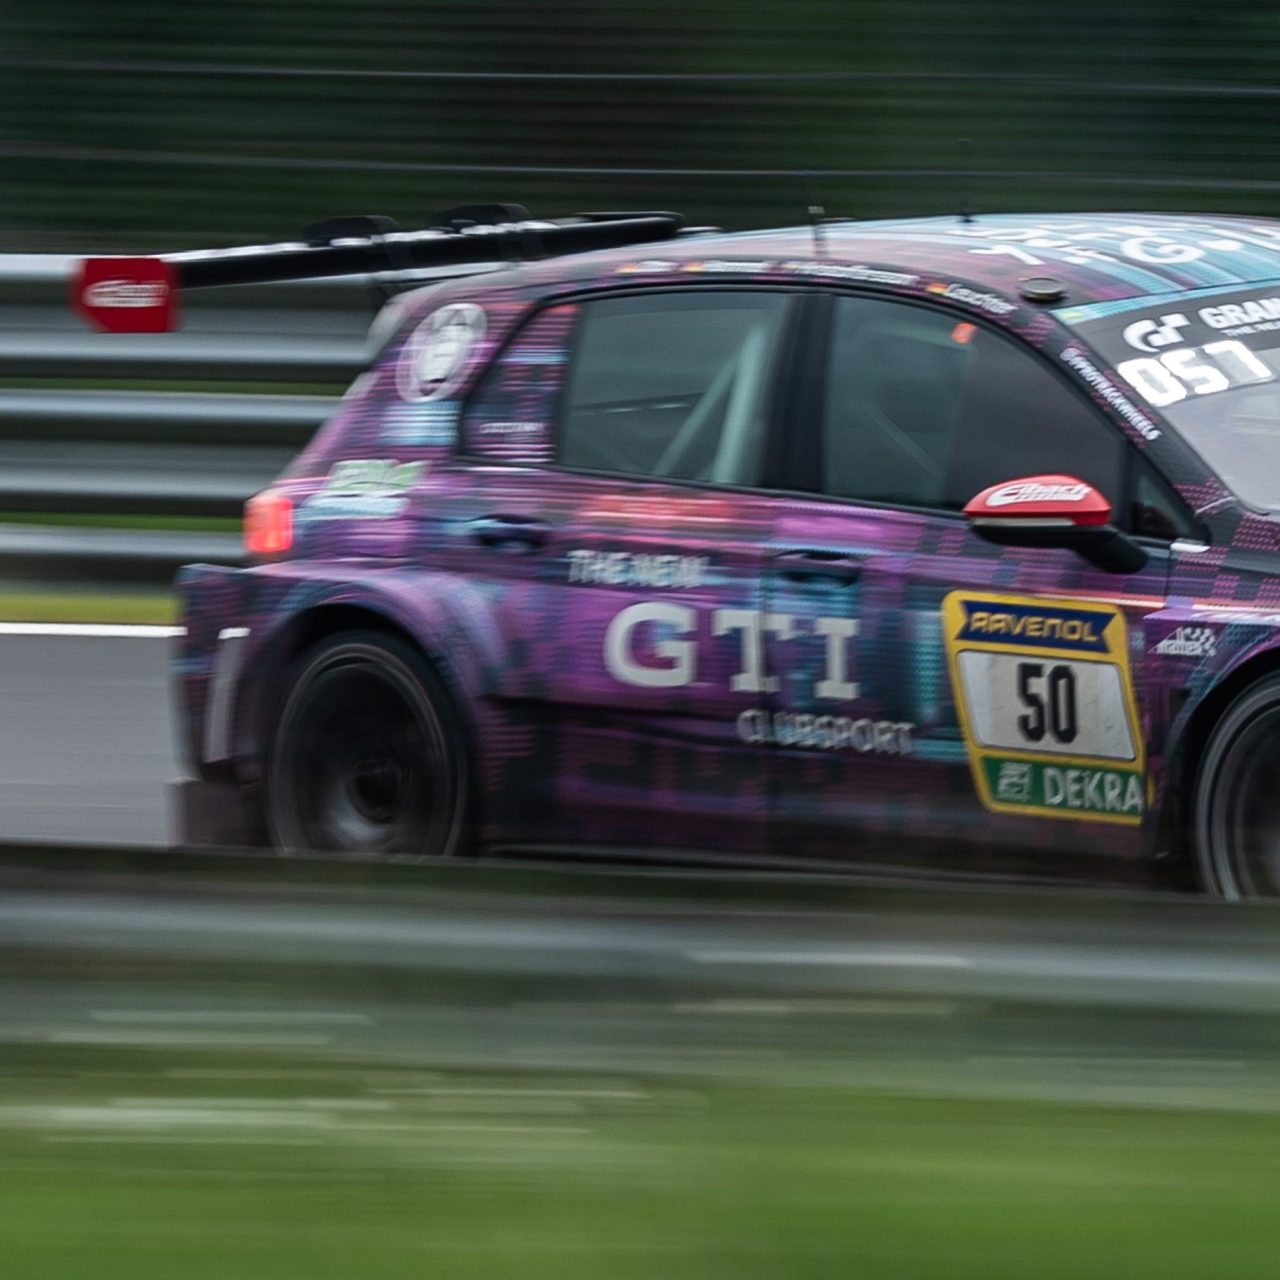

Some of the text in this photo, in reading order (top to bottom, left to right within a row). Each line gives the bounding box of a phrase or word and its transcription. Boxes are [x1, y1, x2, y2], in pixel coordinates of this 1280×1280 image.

[566, 549, 632, 584] THE
[969, 611, 1099, 643] RAVENOL
[603, 601, 862, 700] GTI
[1017, 662, 1077, 744] 50
[1043, 767, 1143, 812] DEKRA
